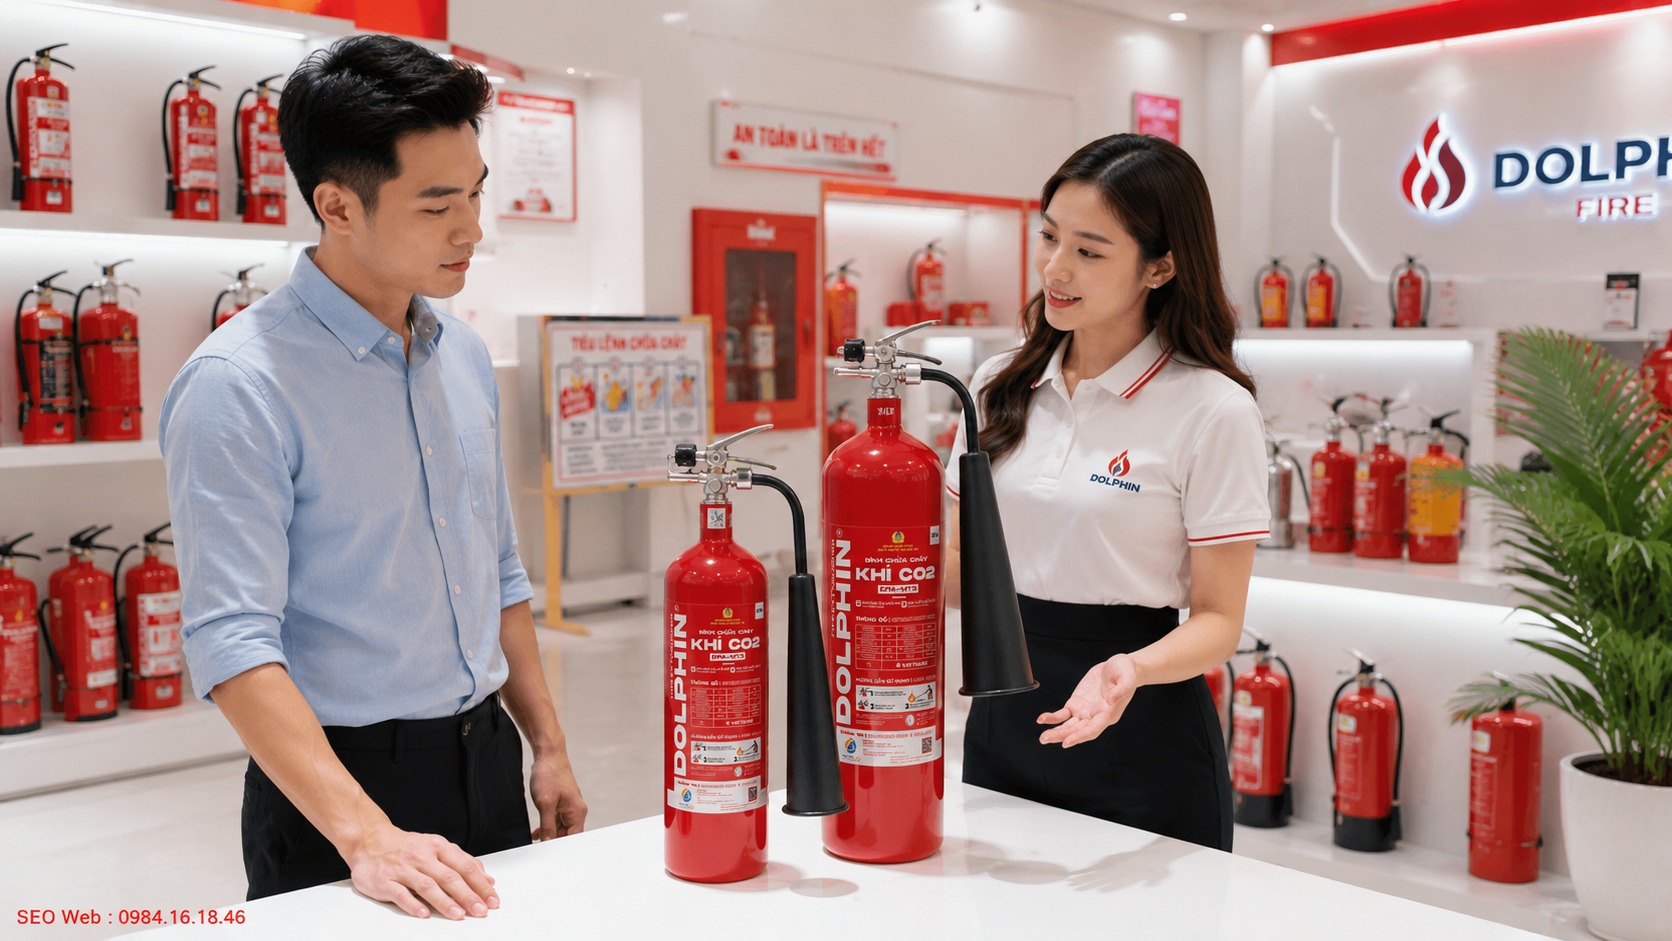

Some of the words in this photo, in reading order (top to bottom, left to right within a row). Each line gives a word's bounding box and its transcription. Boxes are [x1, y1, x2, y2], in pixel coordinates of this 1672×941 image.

[733, 124, 754, 143] AN
[759, 123, 797, 148] TOÀN
[802, 127, 818, 151] LÀ
[1576, 194, 1655, 217] FIRE
[1089, 474, 1141, 493] DOLPHIN
[855, 564, 892, 582] KHÍ
[899, 565, 936, 582] CO2
[691, 636, 722, 651] KHÍ
[728, 636, 760, 651] CO2
[836, 539, 851, 725] DOLPHIN
[674, 613, 687, 776] DOLPHIN
